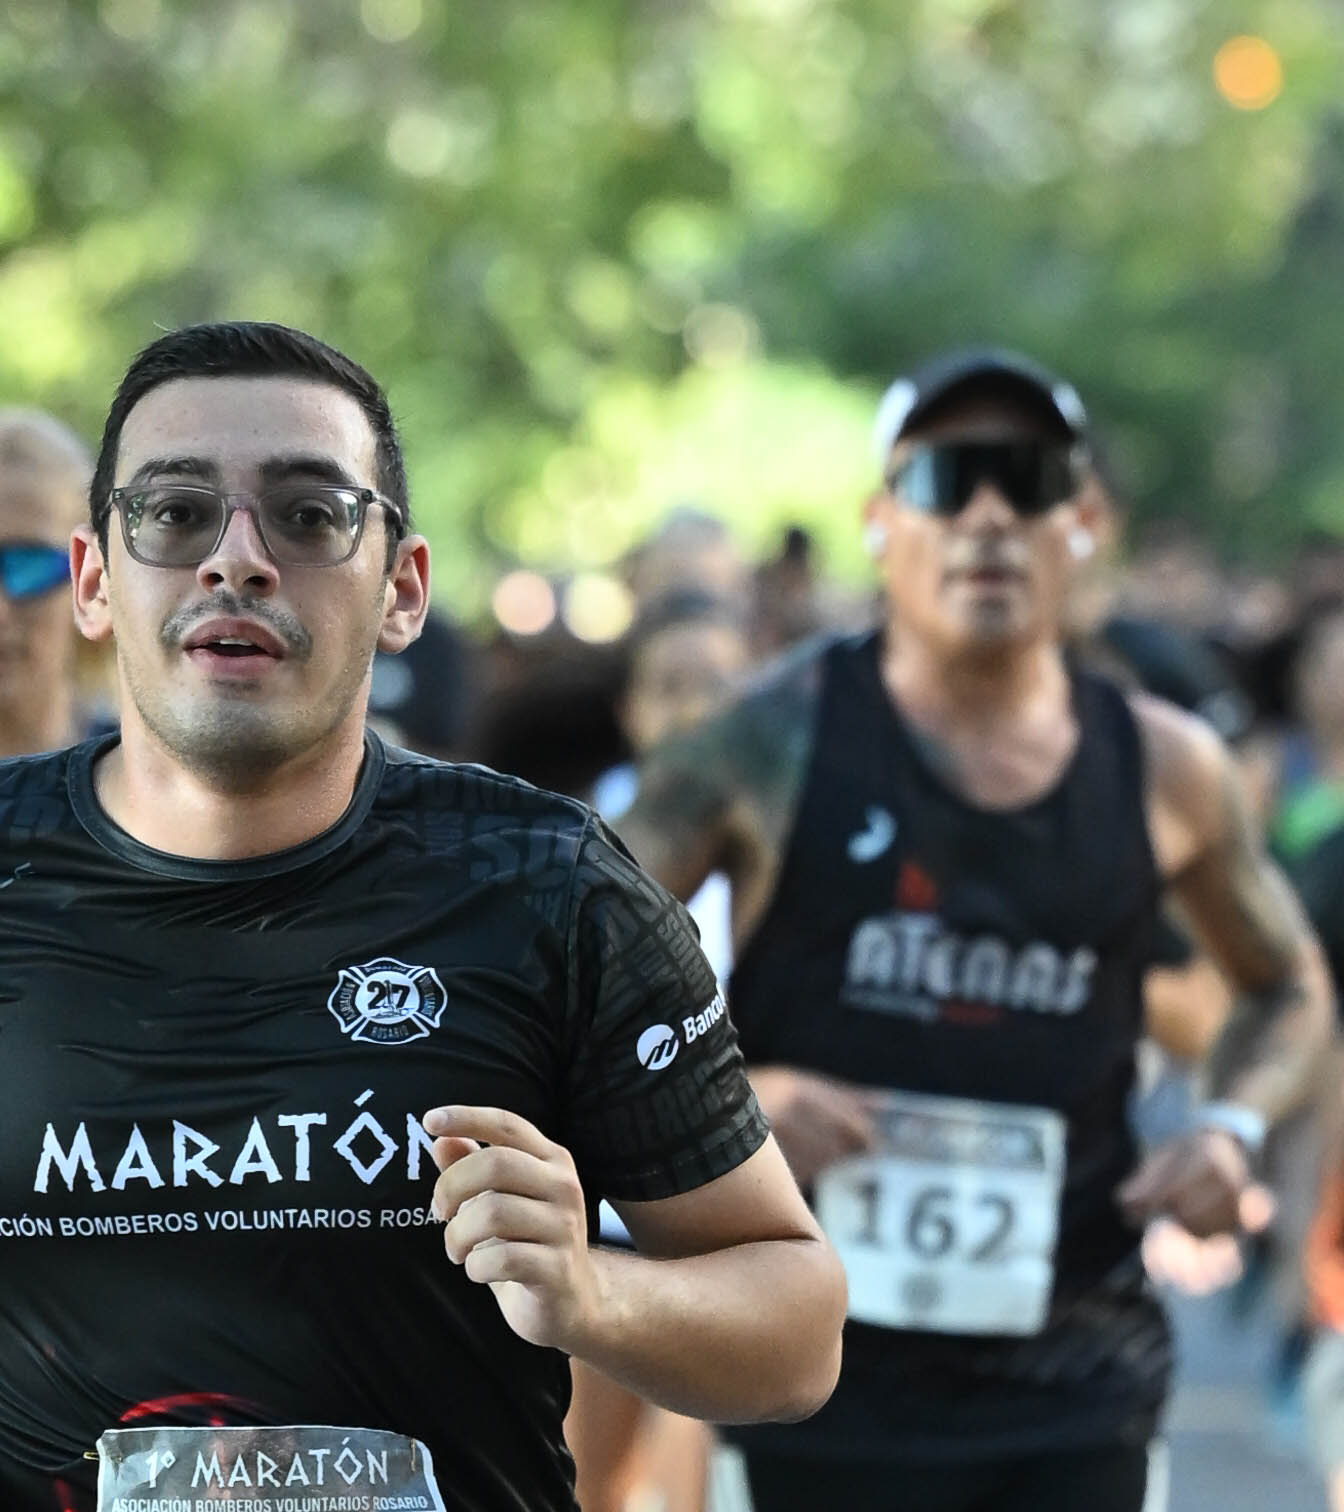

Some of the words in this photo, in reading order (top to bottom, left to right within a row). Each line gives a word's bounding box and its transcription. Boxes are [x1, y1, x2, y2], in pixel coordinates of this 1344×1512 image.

[682, 994, 724, 1045] Banco
[59, 1211, 198, 1237] BOMBEROS
[204, 1207, 372, 1232] VOLUNTARIOS
[379, 1206, 448, 1228] ROSA
[852, 1178, 1016, 1268] 162
[190, 1436, 388, 1489] MARATÓN
[372, 1495, 429, 1511] ROSARIO
